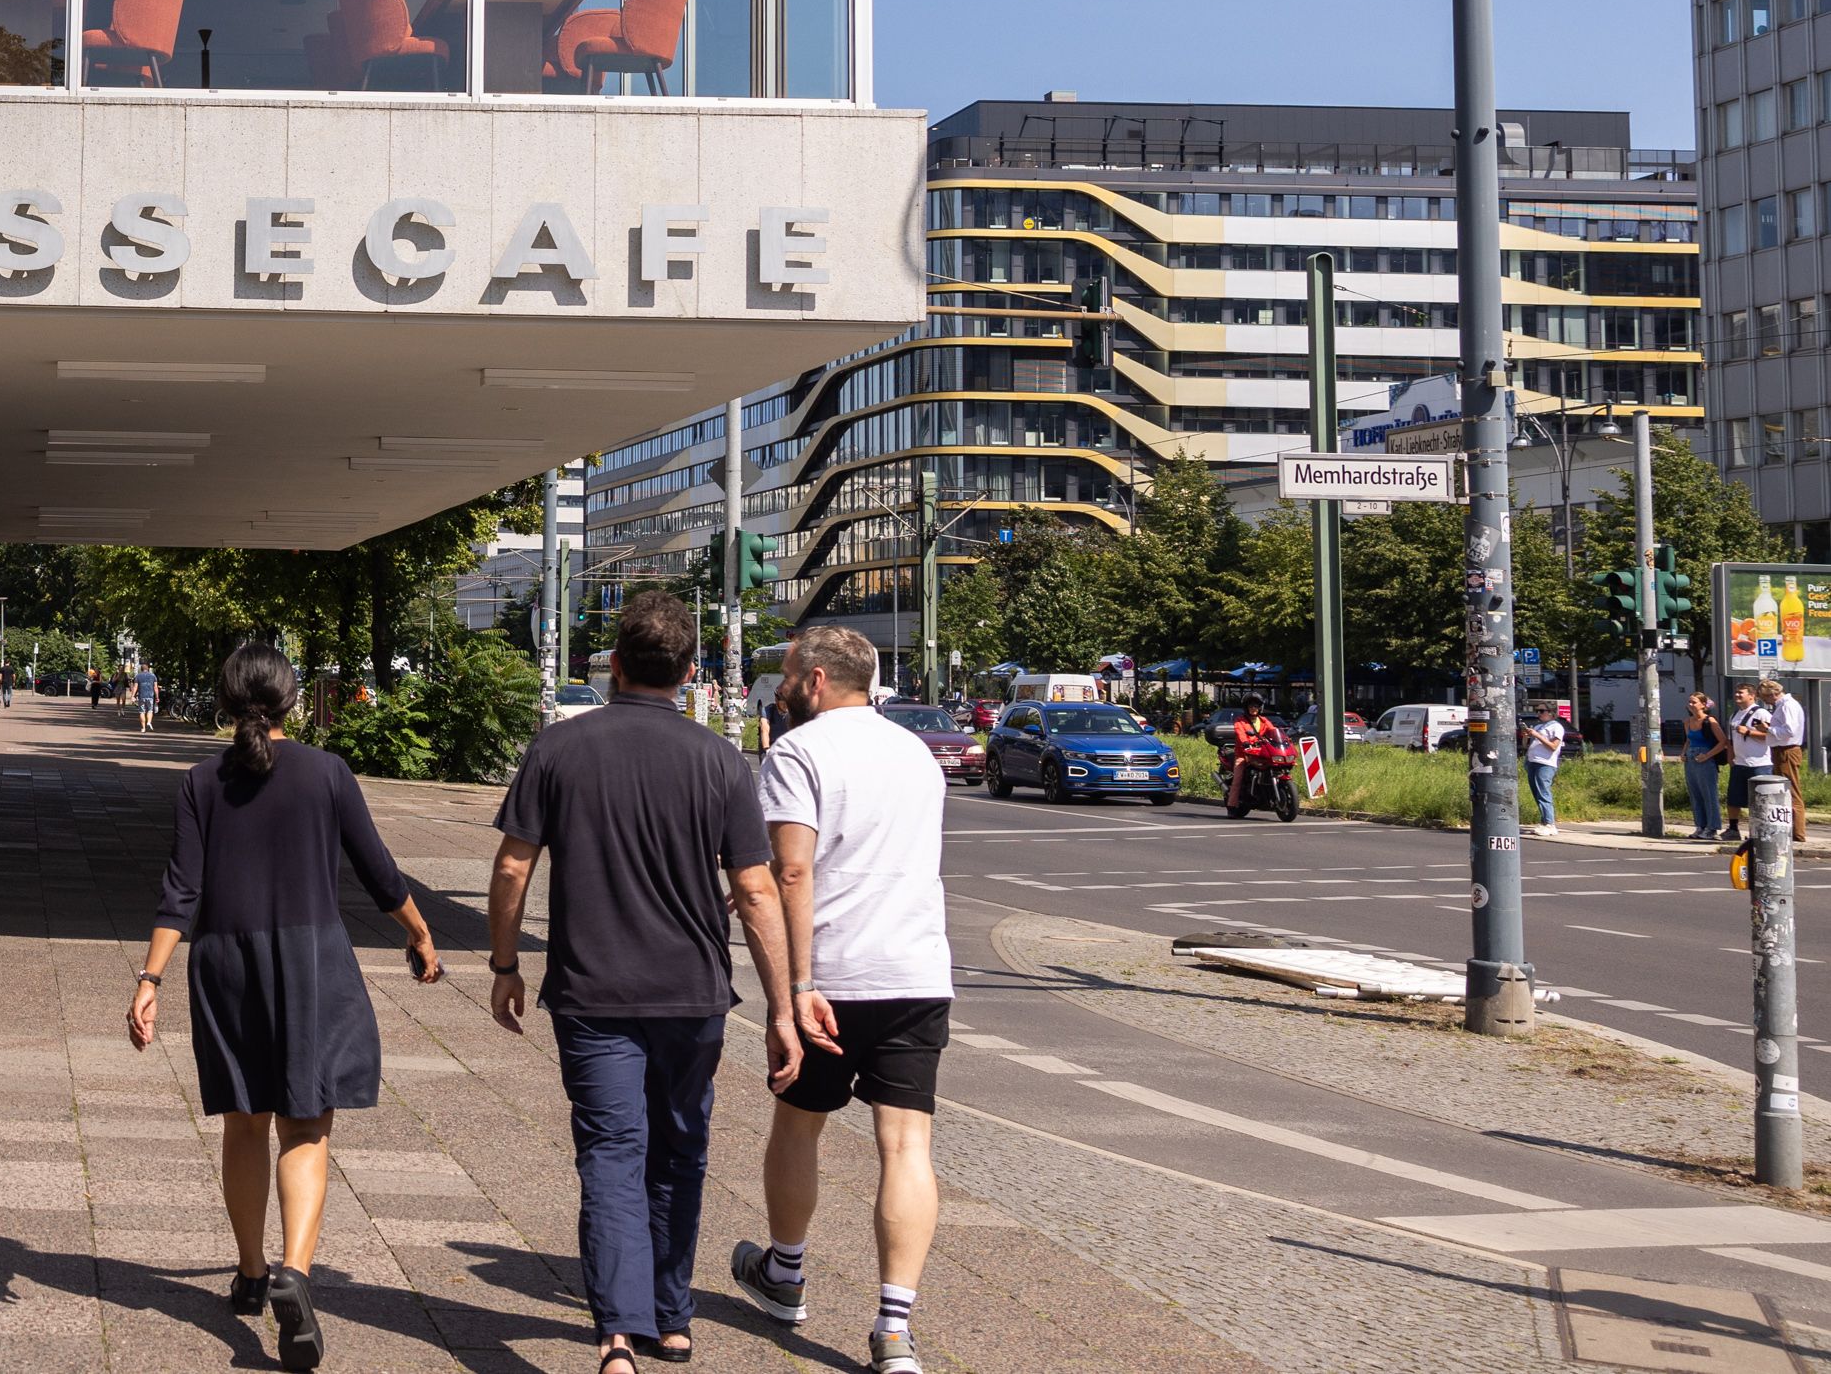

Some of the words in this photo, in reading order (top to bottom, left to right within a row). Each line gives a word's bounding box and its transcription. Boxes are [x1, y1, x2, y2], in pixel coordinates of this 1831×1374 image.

[1294, 463, 1438, 490] Memhardstraße
[1808, 600, 1828, 609] Pure
[1760, 641, 1772, 655] P
[1488, 837, 1516, 850] FACH
